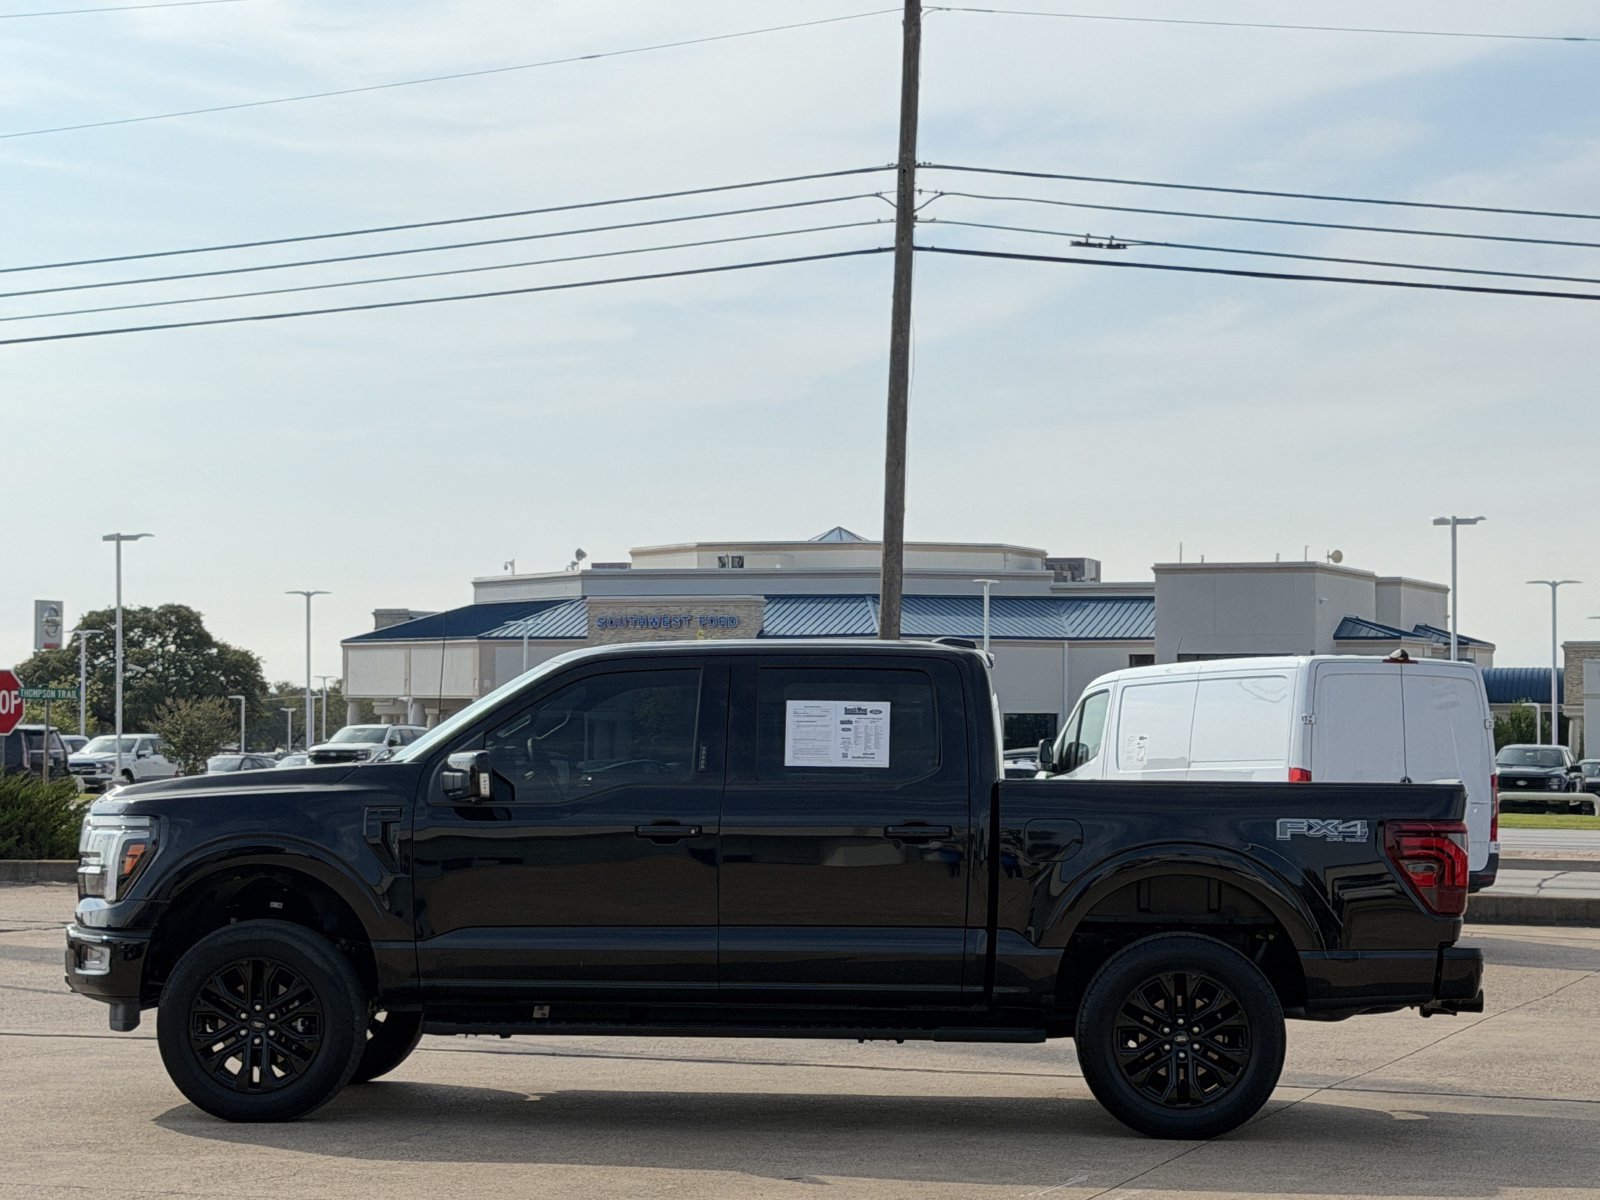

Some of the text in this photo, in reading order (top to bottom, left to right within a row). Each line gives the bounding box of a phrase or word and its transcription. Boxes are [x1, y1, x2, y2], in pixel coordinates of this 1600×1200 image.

[596, 614, 739, 629] SOUTHWEST FORD
[20, 689, 78, 699] THOMPSON TRAIL
[1276, 818, 1368, 841] FX4
